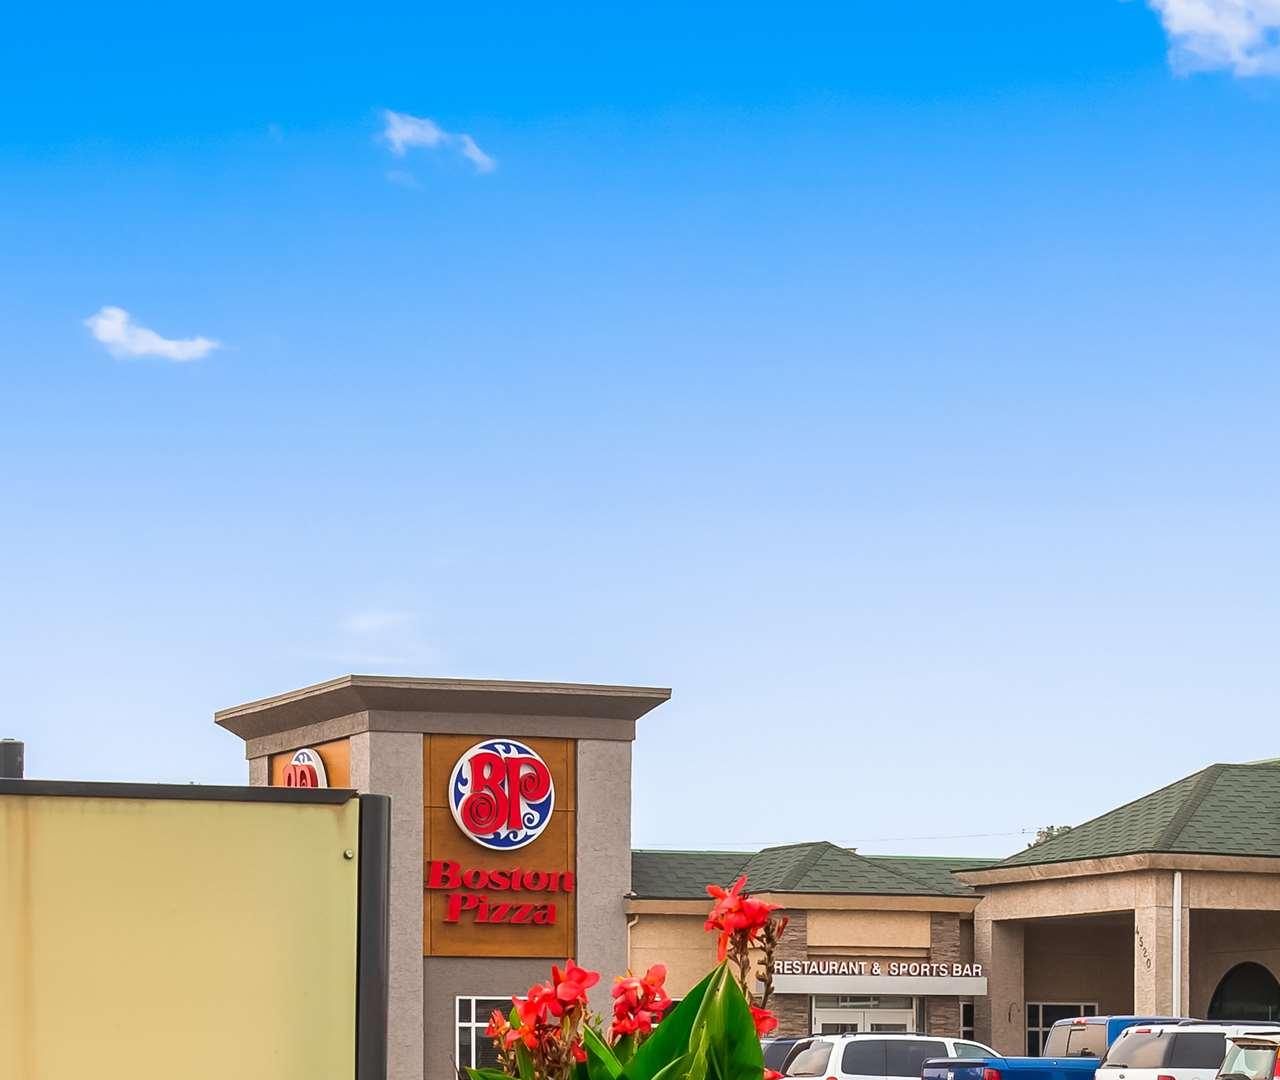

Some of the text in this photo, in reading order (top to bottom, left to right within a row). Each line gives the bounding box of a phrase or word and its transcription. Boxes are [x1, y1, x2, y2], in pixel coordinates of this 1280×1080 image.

[461, 752, 553, 836] BP
[424, 859, 575, 893] Boston
[442, 892, 558, 926] Pizza
[774, 960, 983, 977] RESTAURANT & SPORTS BAR
